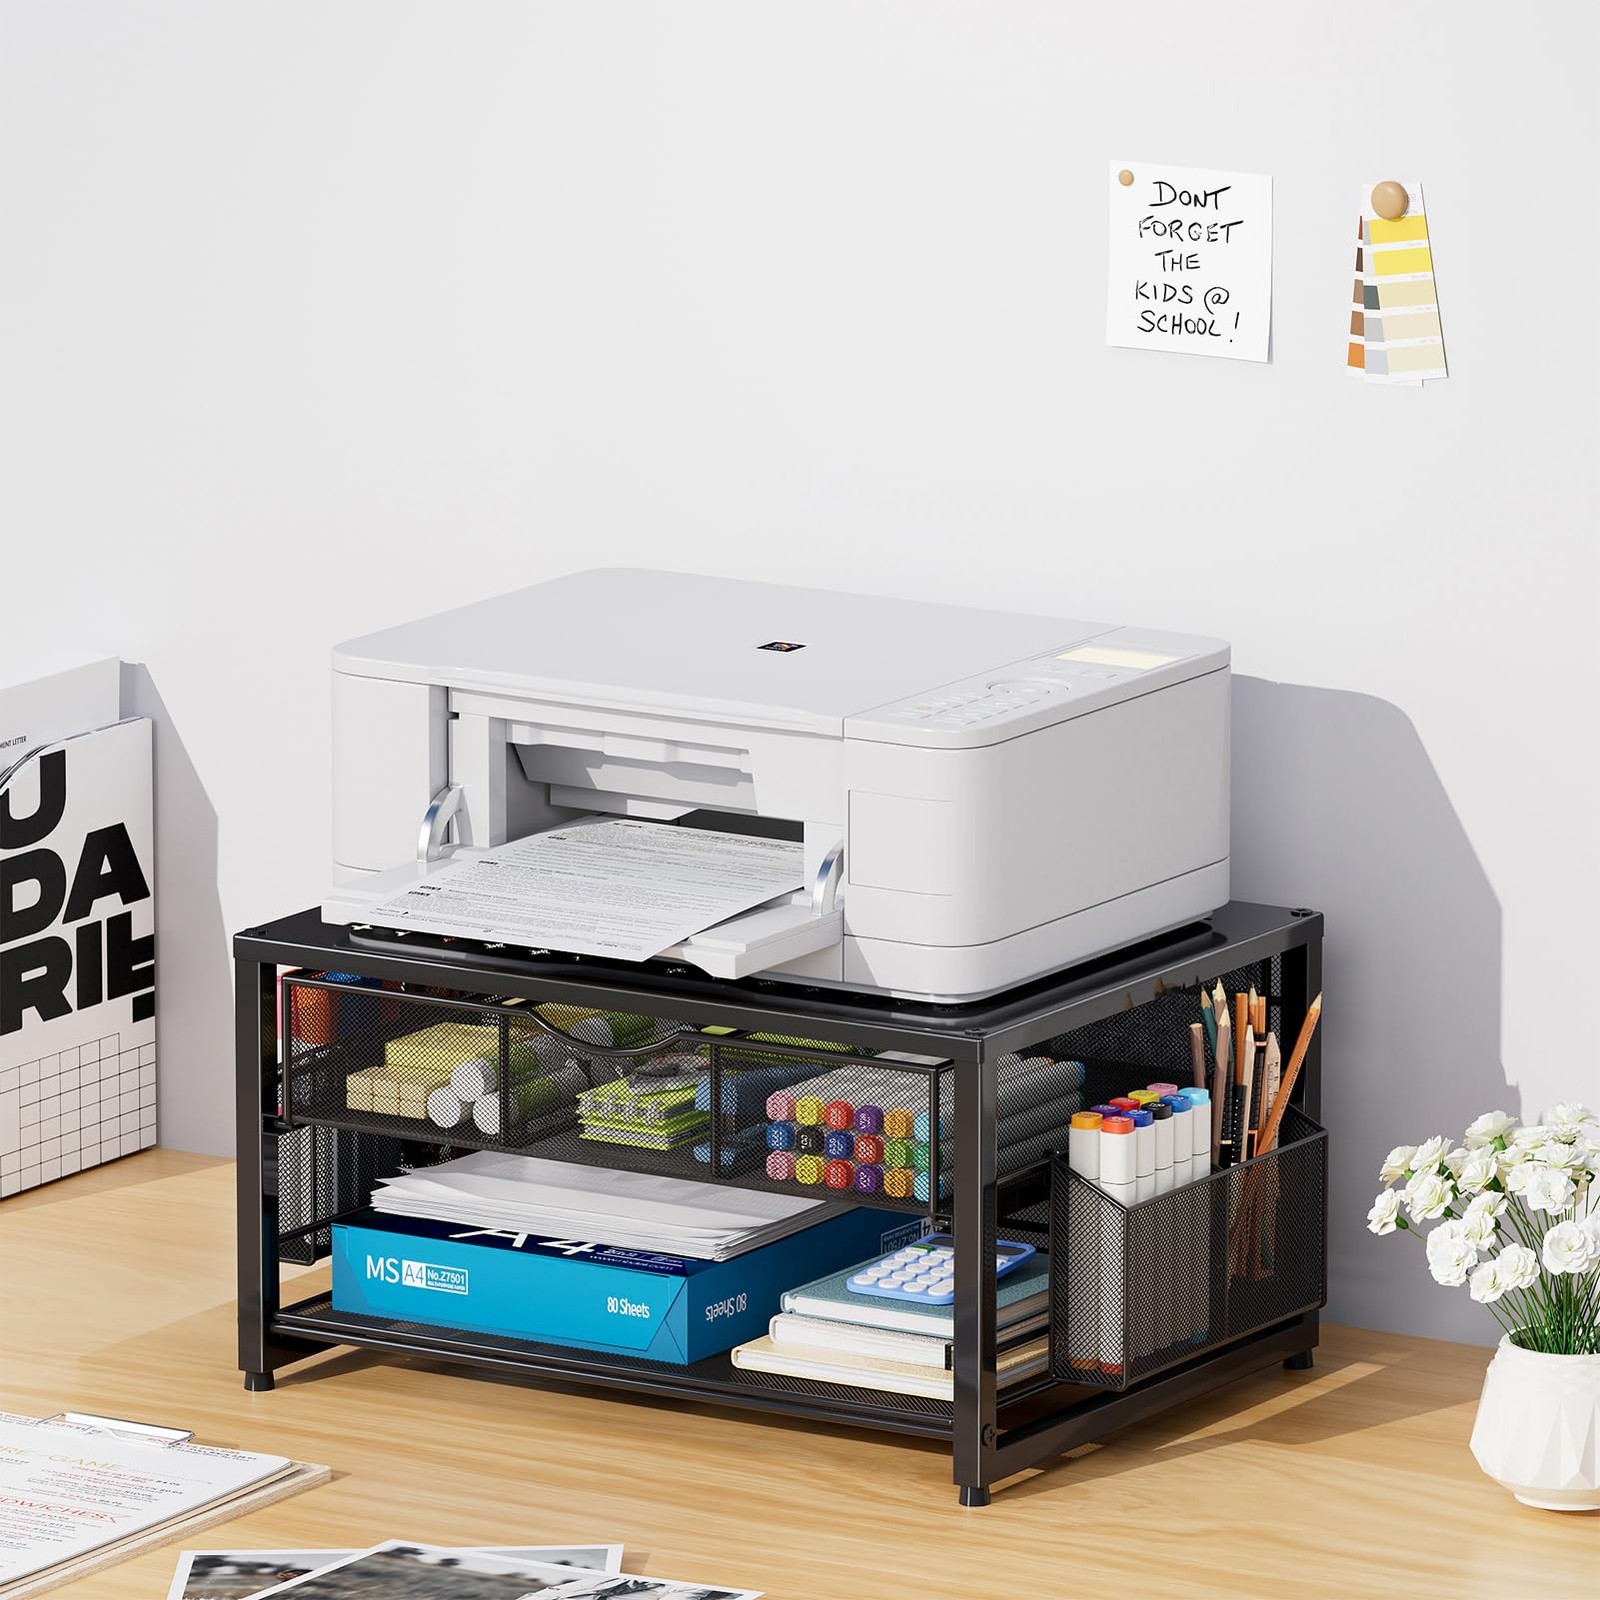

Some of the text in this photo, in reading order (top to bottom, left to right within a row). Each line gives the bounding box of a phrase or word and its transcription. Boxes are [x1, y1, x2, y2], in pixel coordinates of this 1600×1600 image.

[1149, 181, 1231, 210] DONT
[1138, 215, 1244, 244] FORGET
[1154, 249, 1201, 272] THE
[1135, 280, 1230, 315] KIDS @
[12, 735, 27, 746] LETTER
[366, 1254, 400, 1284] MS
[404, 1263, 424, 1285] A4
[607, 1296, 650, 1318] 80 Sheets
[705, 1292, 748, 1322] 80 Sheets
